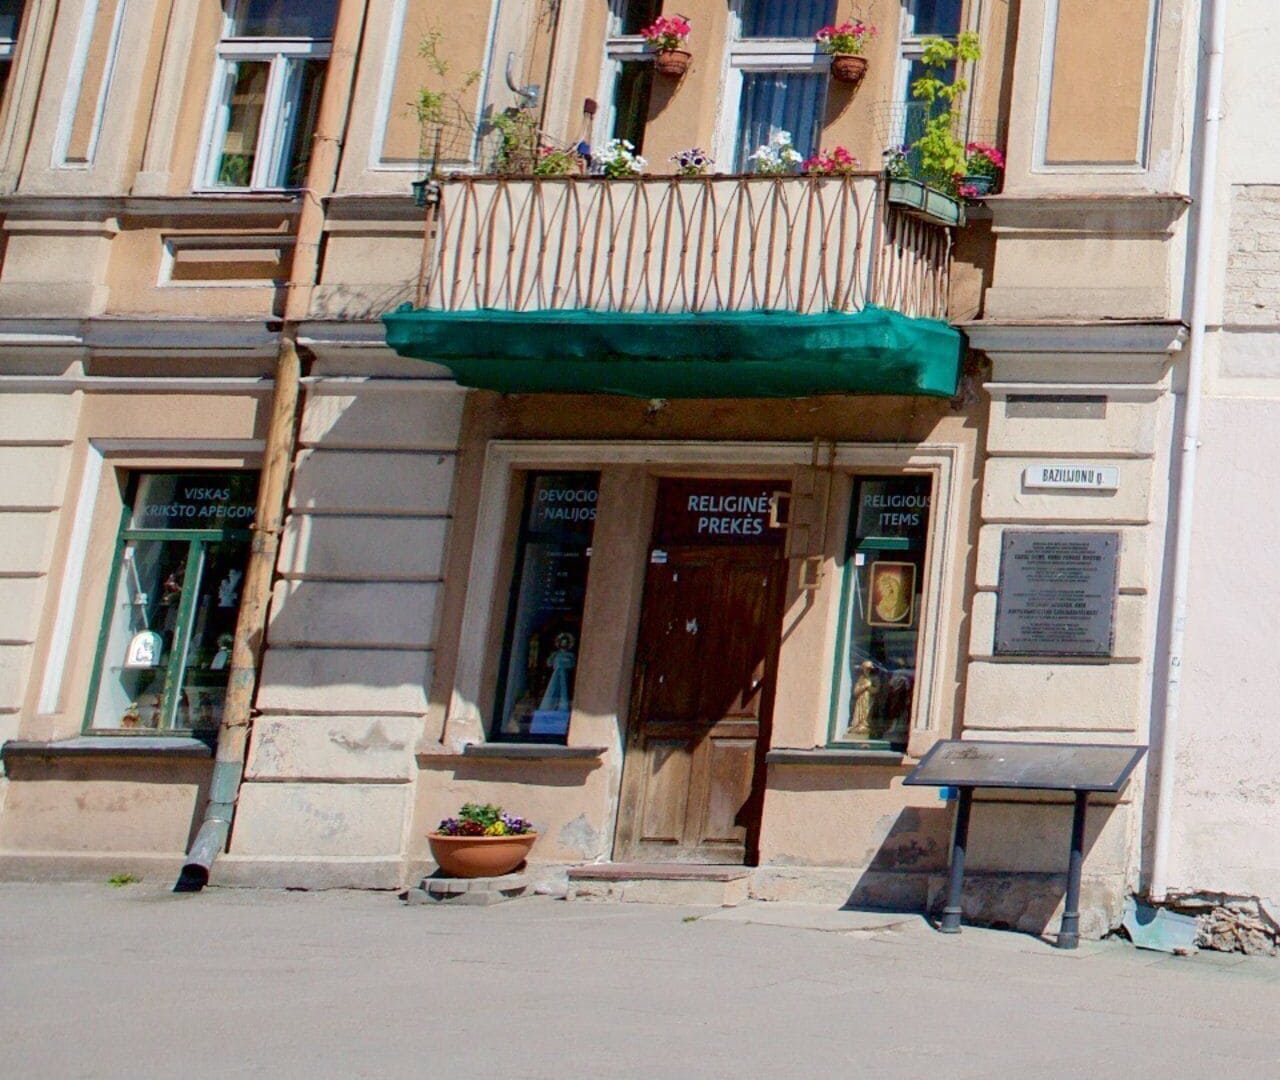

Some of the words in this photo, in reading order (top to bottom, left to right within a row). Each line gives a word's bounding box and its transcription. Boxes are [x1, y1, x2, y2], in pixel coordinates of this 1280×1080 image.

[184, 487, 231, 500] VISKAS
[539, 489, 598, 502] DEVOCIO
[144, 502, 196, 517] KRIKŠTO
[697, 513, 763, 535] PREKĖS
[879, 513, 920, 526] ITEMS
